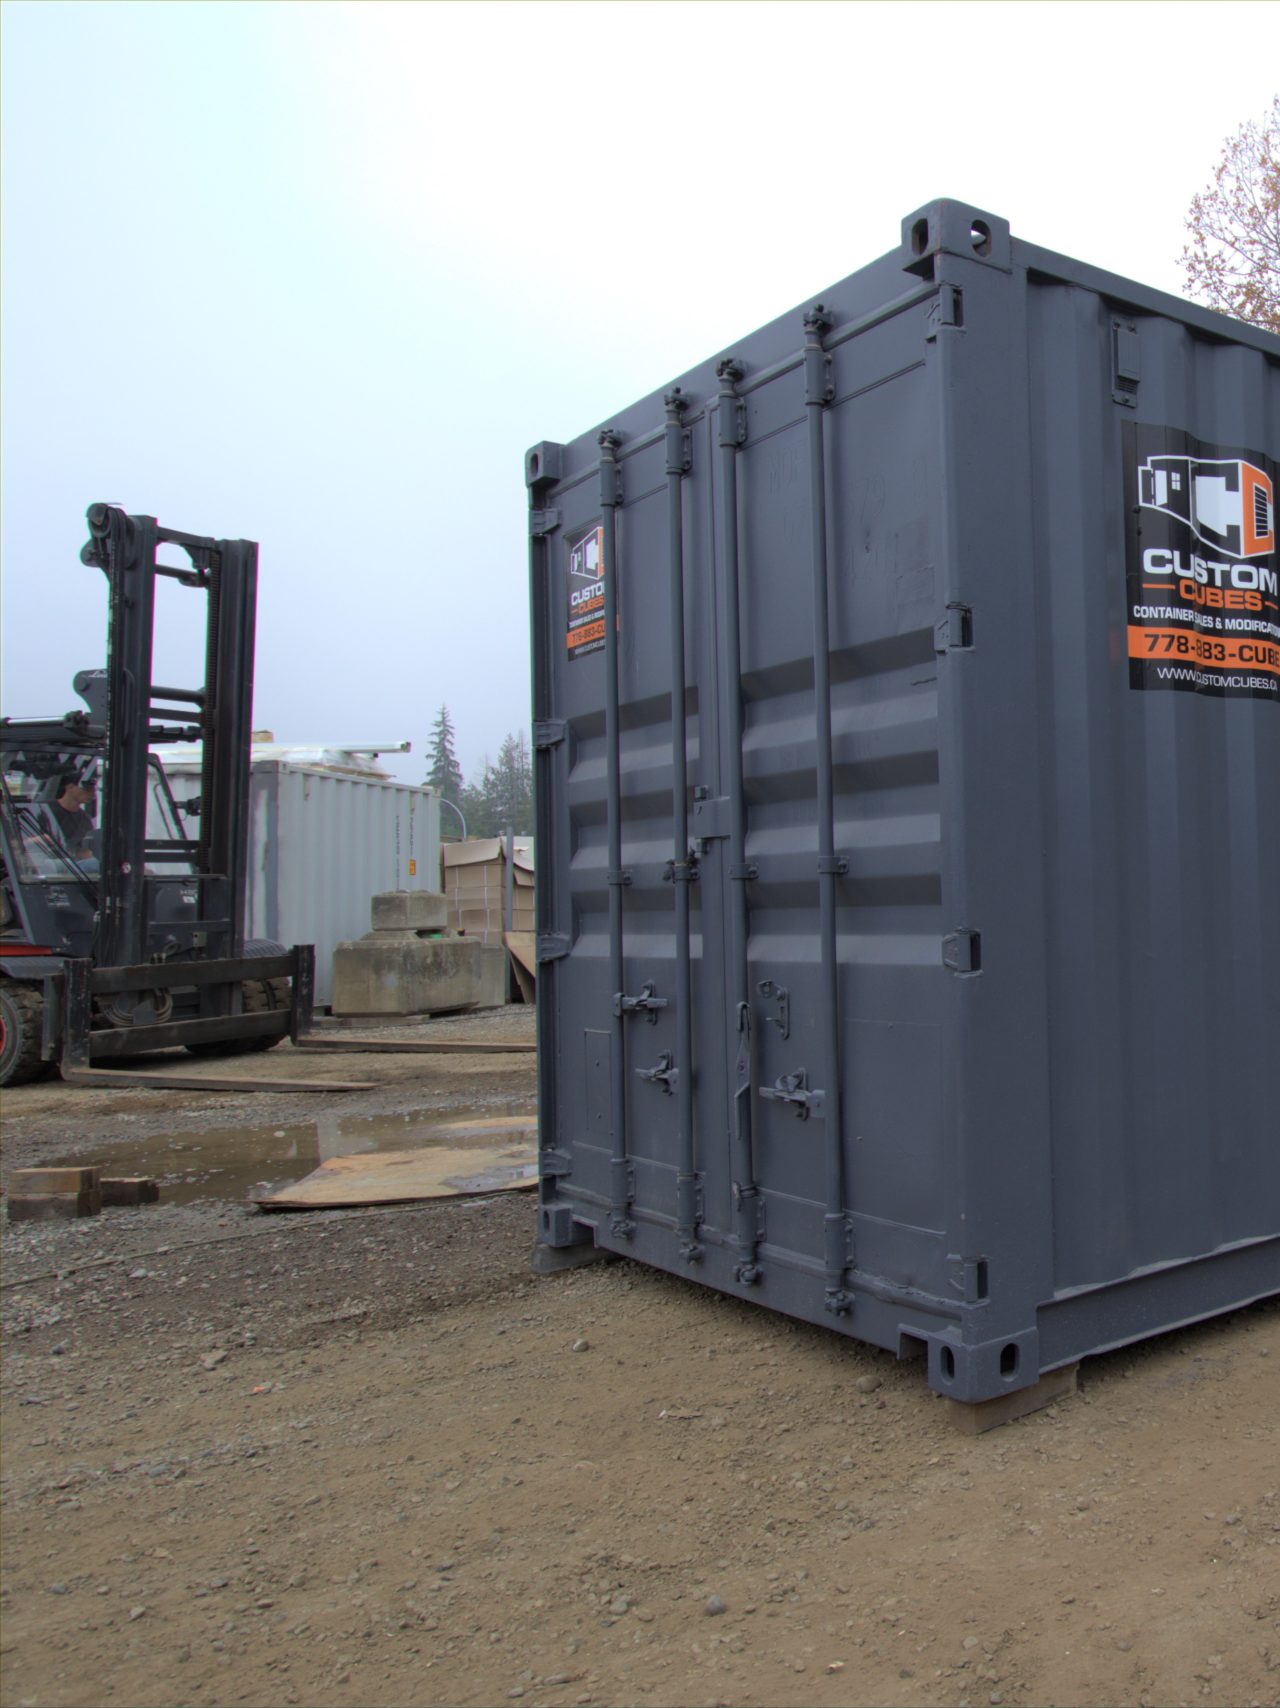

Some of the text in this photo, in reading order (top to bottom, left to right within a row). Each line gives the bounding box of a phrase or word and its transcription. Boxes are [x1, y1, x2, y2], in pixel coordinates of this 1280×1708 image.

[1143, 548, 1278, 597] CUSTOM
[571, 581, 605, 606] CUSTO
[1179, 579, 1263, 611] CUBES
[1133, 605, 1194, 622] CONTAINER
[1215, 617, 1223, 630] &
[1144, 633, 1280, 668] 778-883-CUBE
